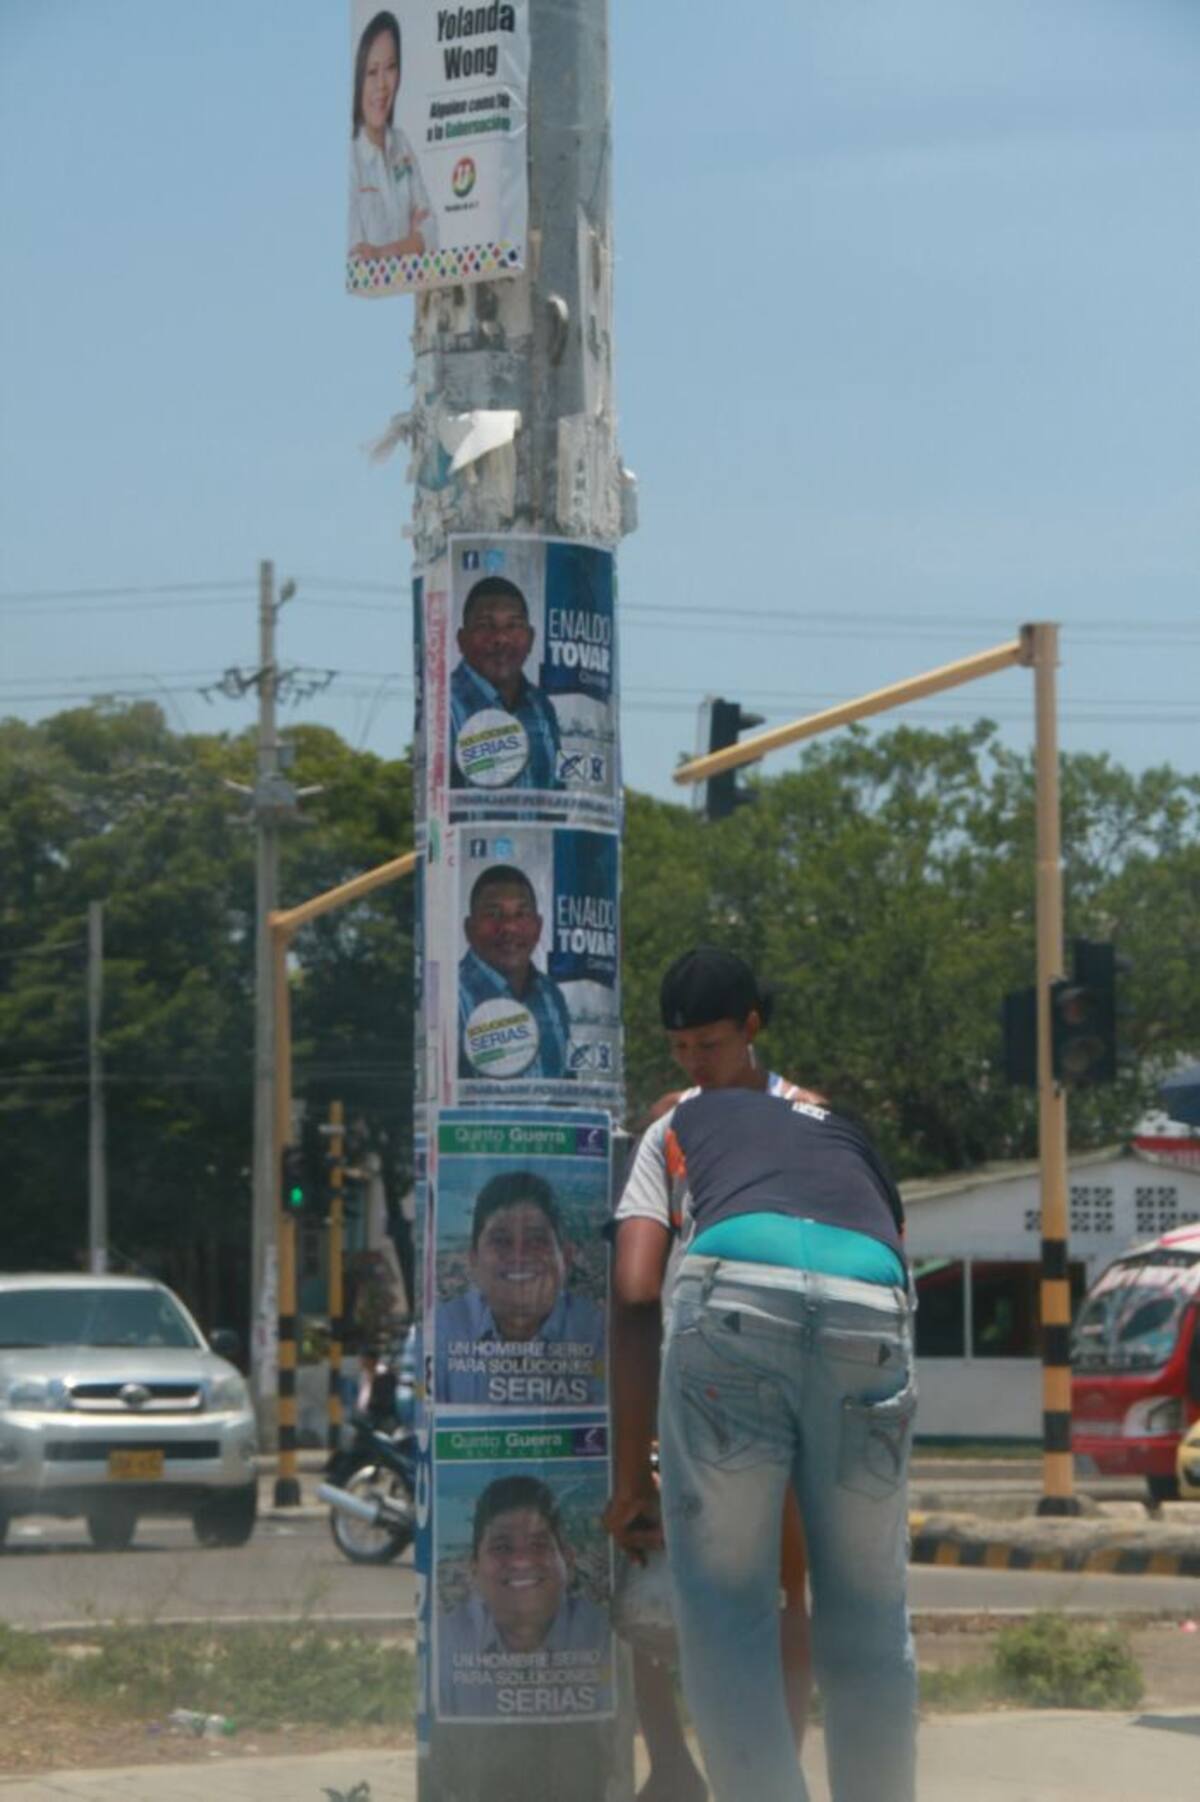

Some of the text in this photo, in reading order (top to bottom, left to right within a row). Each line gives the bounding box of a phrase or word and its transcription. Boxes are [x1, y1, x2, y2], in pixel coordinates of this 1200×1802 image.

[437, 0, 516, 42] Yolanda
[444, 44, 498, 80] Wong
[548, 641, 610, 674] TOVAR
[557, 930, 616, 956] TOVAR
[455, 1127, 566, 1144] Quinto Guerra
[471, 1341, 545, 1357] HOMBRE
[448, 1358, 594, 1375] PARA SOLUCIONES
[488, 1376, 588, 1402] SERIAS
[450, 1432, 562, 1448] Quinto Guerra
[496, 1686, 595, 1712] SERIAS
